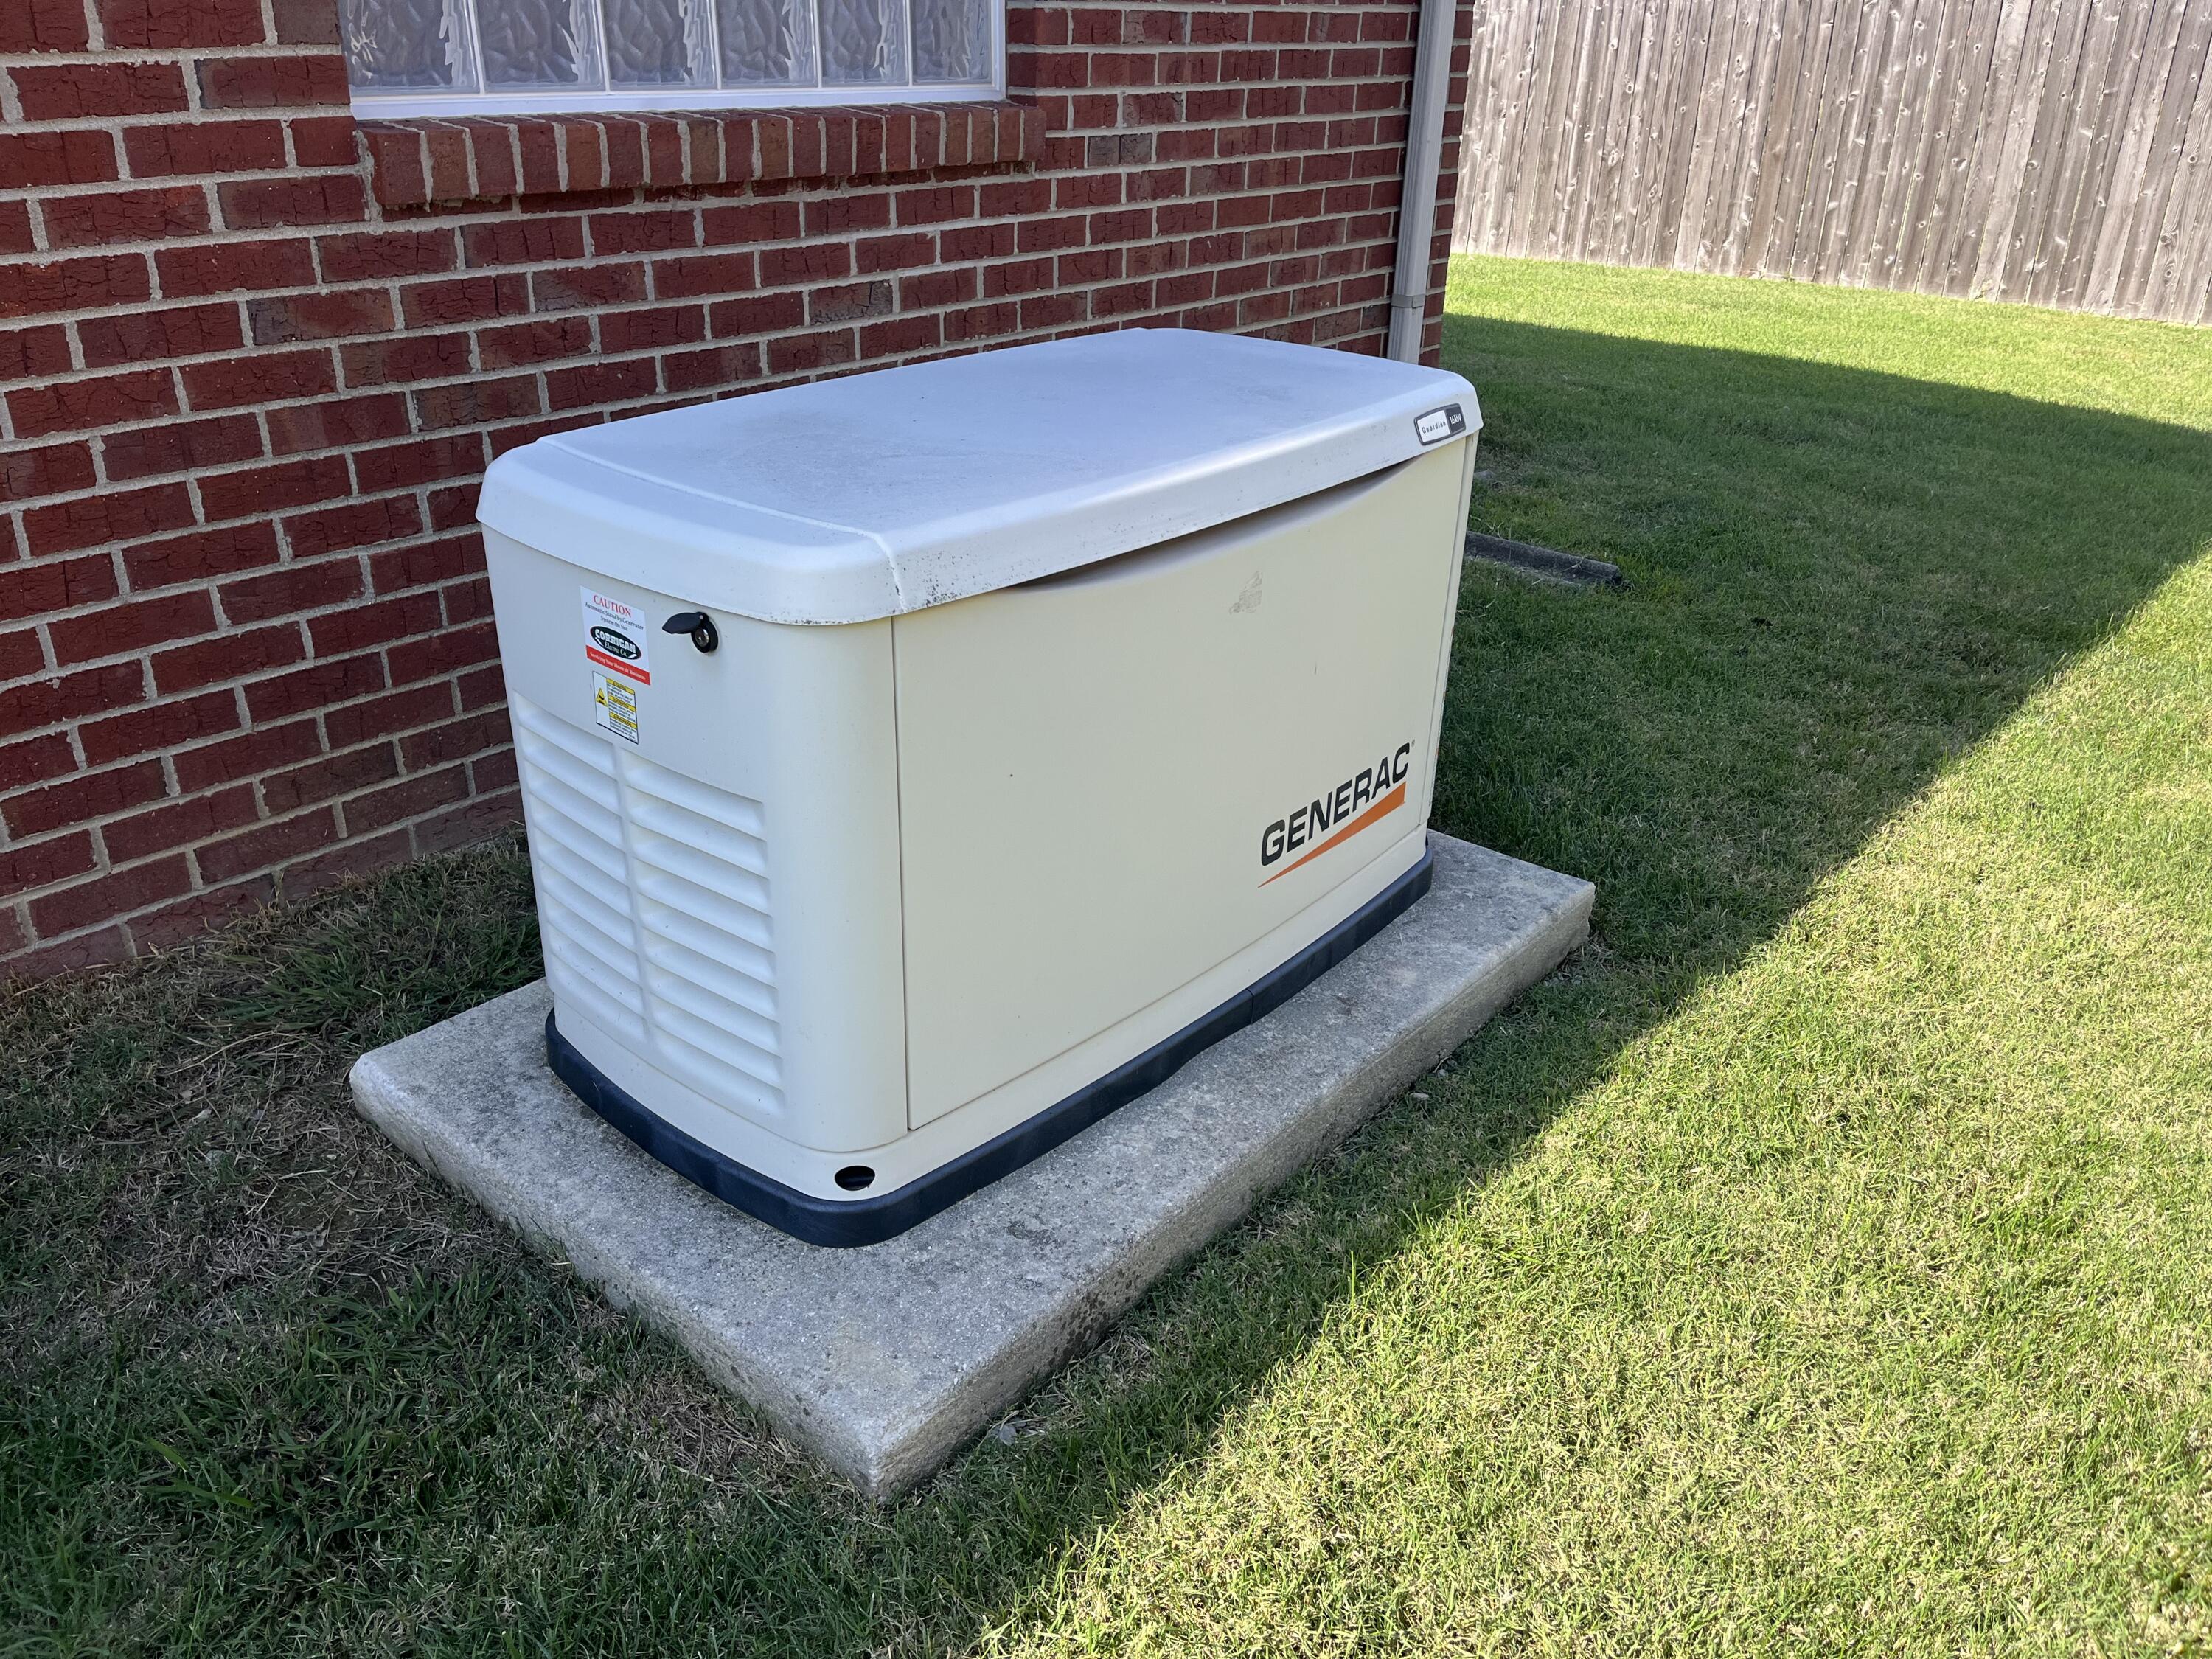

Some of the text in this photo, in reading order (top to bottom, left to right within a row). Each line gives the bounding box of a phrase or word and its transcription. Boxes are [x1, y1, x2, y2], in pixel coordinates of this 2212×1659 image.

[593, 594, 632, 618] CAUTION
[622, 617, 644, 630] Generator
[594, 628, 636, 653] CORRIGAN
[1262, 742, 1410, 866] GENERAC
